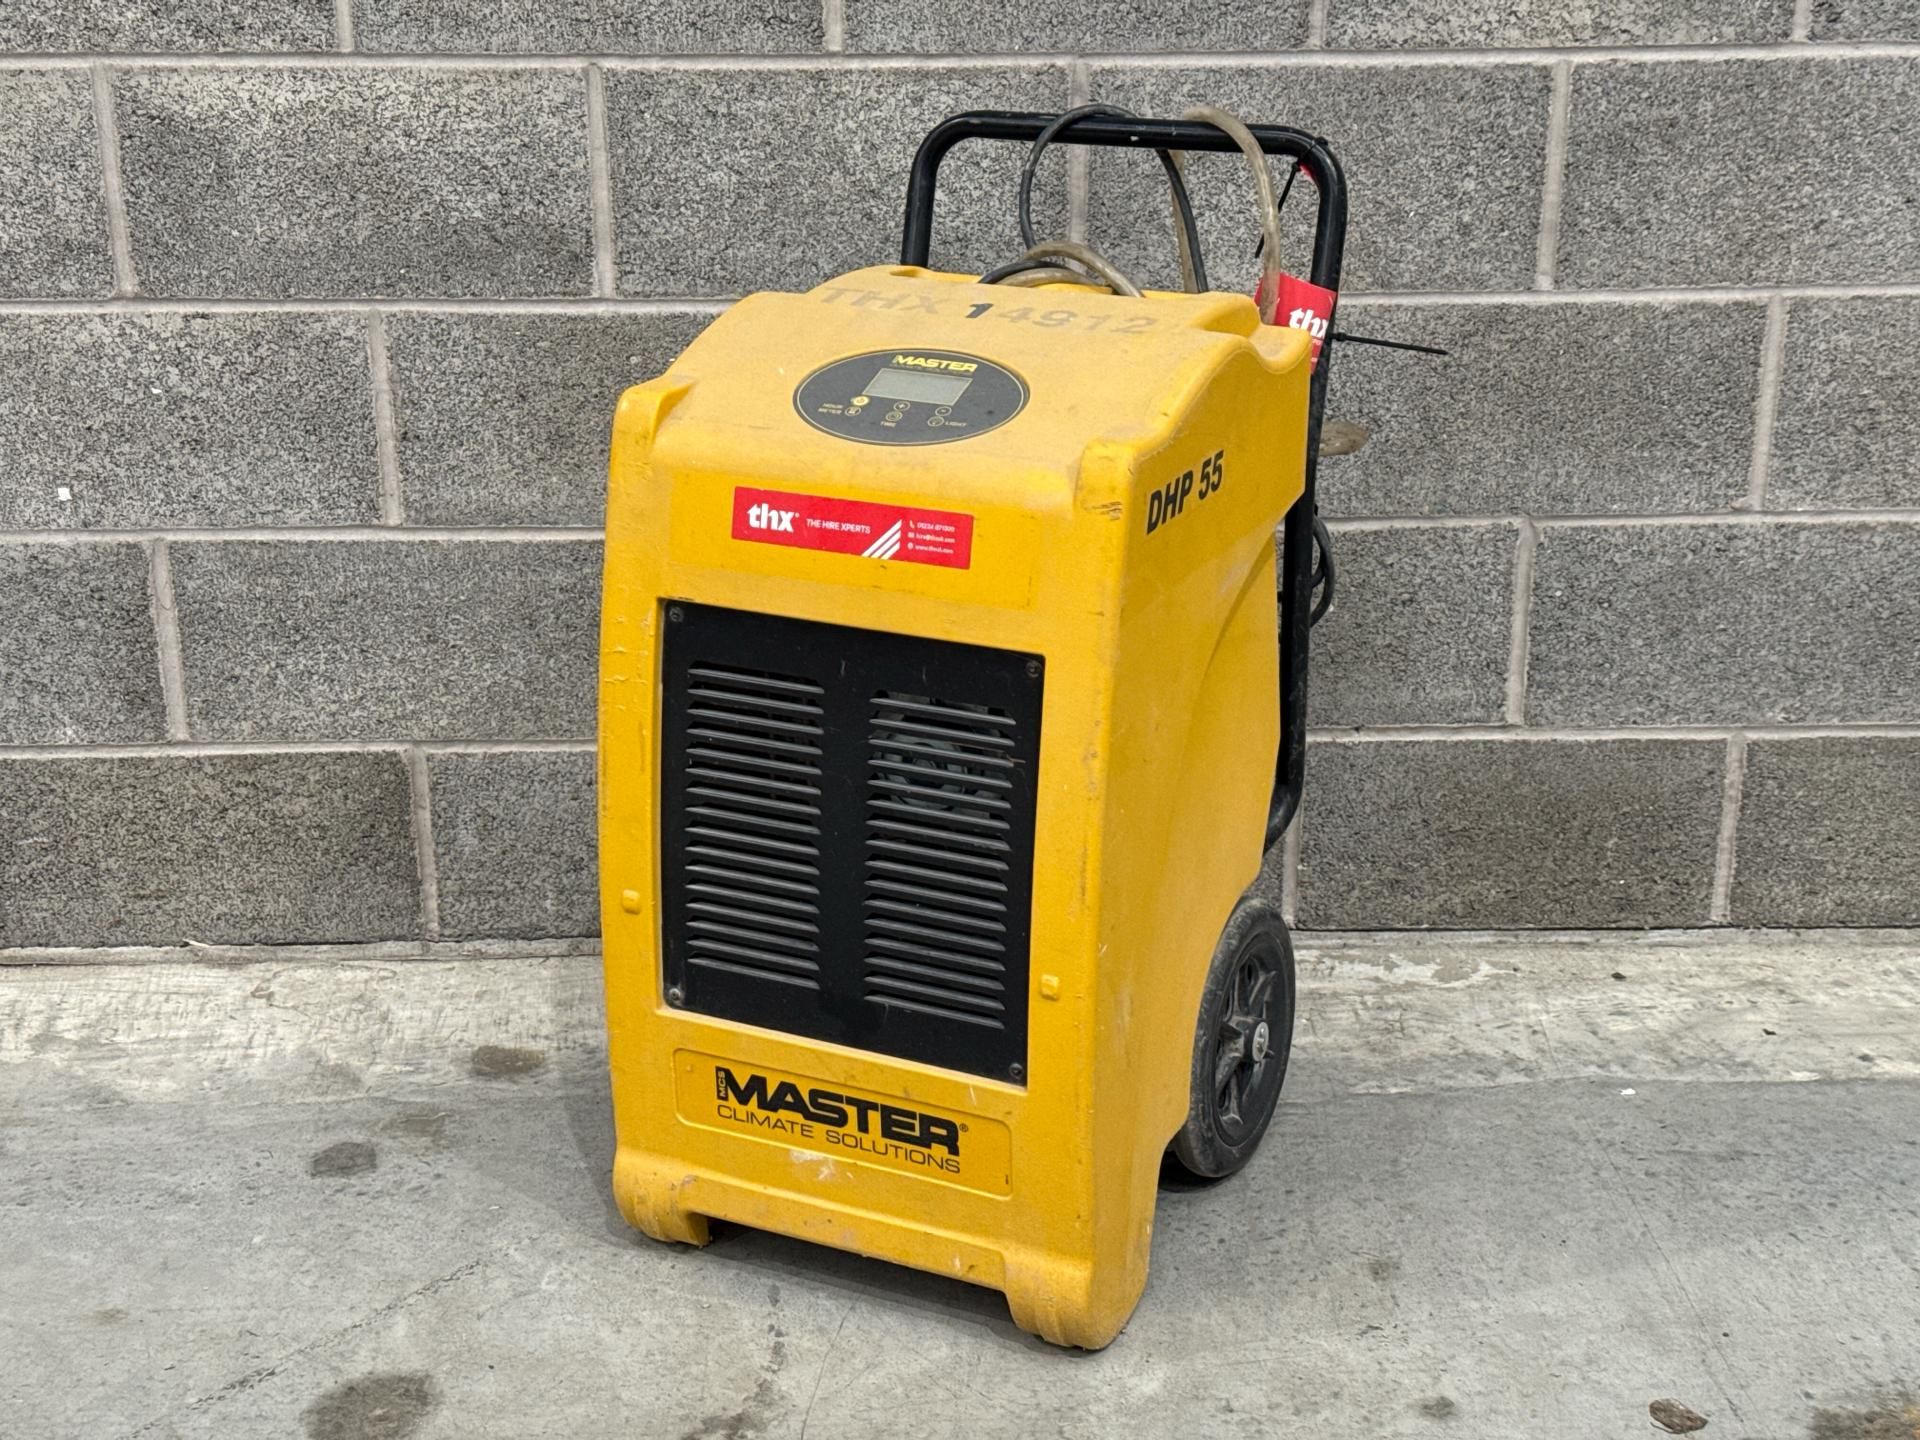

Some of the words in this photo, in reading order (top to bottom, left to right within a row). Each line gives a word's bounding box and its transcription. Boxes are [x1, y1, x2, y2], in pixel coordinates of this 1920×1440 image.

[820, 287, 940, 313] THX
[892, 354, 979, 373] MASTER
[1146, 470, 1194, 535] DHP
[1198, 450, 1225, 501] 55
[747, 503, 794, 533] thx
[806, 518, 822, 530] THE
[822, 520, 840, 532] HIRE
[840, 522, 871, 534] XPERTS
[719, 1070, 727, 1098] MCS
[715, 1066, 960, 1156] MASTER
[717, 1104, 815, 1138] CLIMATE
[825, 1129, 961, 1174] SOLUTIONS
